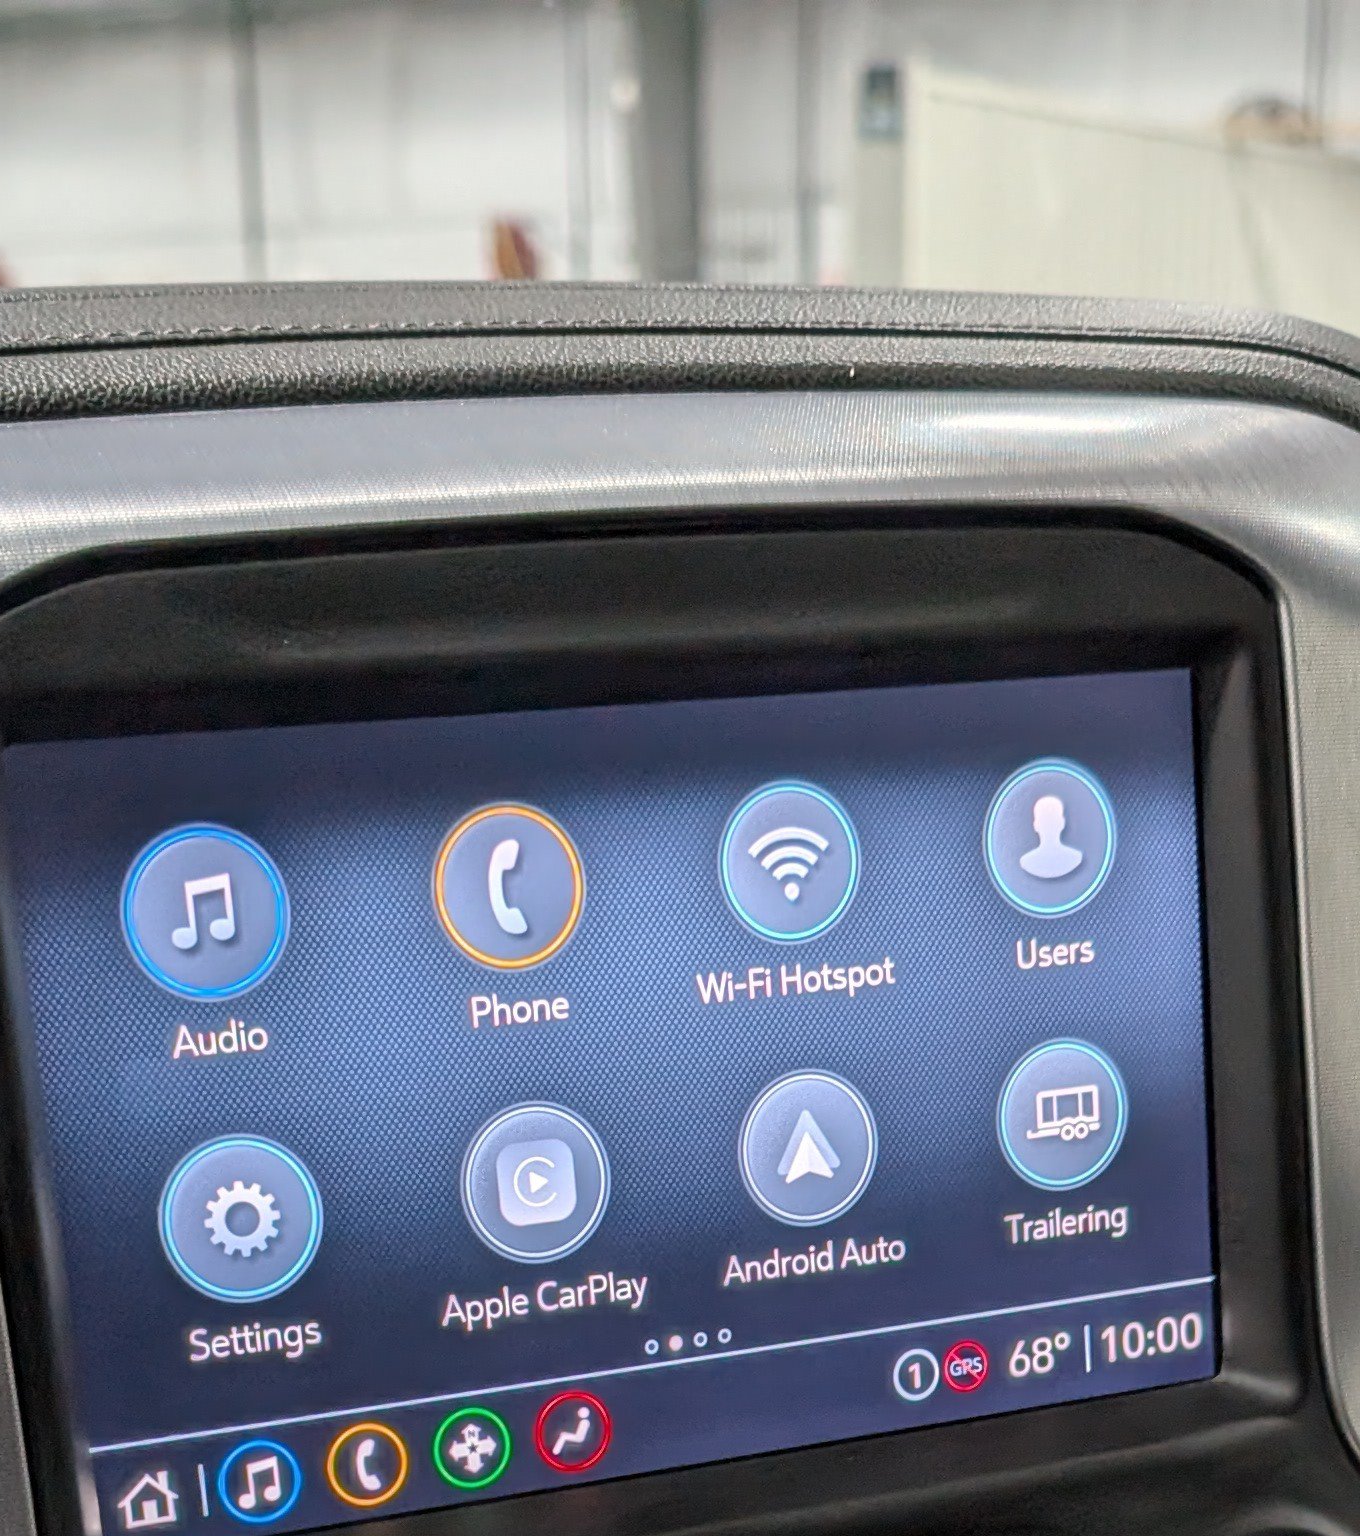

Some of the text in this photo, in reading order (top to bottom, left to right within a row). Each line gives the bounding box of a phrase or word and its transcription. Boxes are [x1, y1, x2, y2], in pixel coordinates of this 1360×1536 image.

[1015, 938, 1095, 969] Users
[696, 956, 896, 1004] Wi-Fi Hotspot
[470, 991, 570, 1028] Phone
[172, 1018, 269, 1060] Audio
[1003, 1204, 1128, 1247] Trailering
[722, 1236, 906, 1287] Android Auto
[441, 1272, 648, 1331] Apple CarPlay
[189, 1319, 323, 1363] Settings
[948, 1354, 983, 1377] GPS
[1100, 1312, 1203, 1363] 10:00
